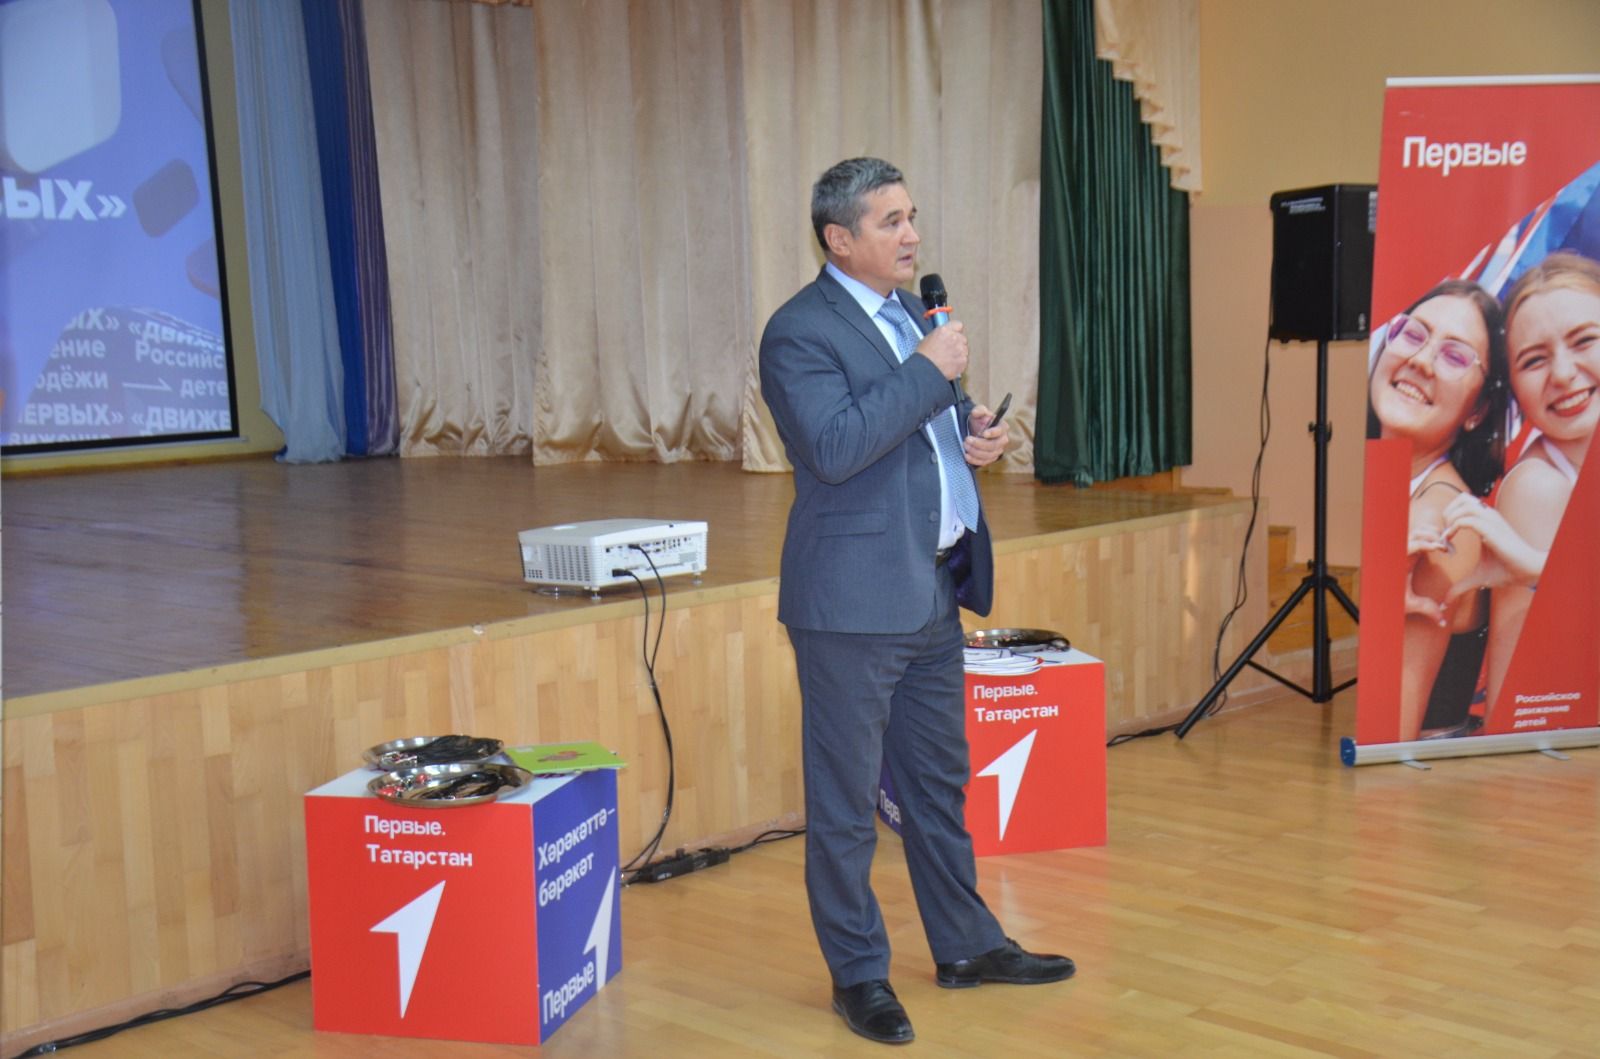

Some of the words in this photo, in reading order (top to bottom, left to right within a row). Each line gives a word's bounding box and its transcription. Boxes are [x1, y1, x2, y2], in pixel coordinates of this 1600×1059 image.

[1402, 135, 1527, 177] Первые
[973, 684, 1038, 702] Первые.
[974, 705, 1059, 724] Татарстан
[364, 815, 446, 839] Первые.
[366, 844, 473, 870] Татарстан
[538, 852, 595, 907] бәрәкәт
[542, 960, 594, 1024] Первые
